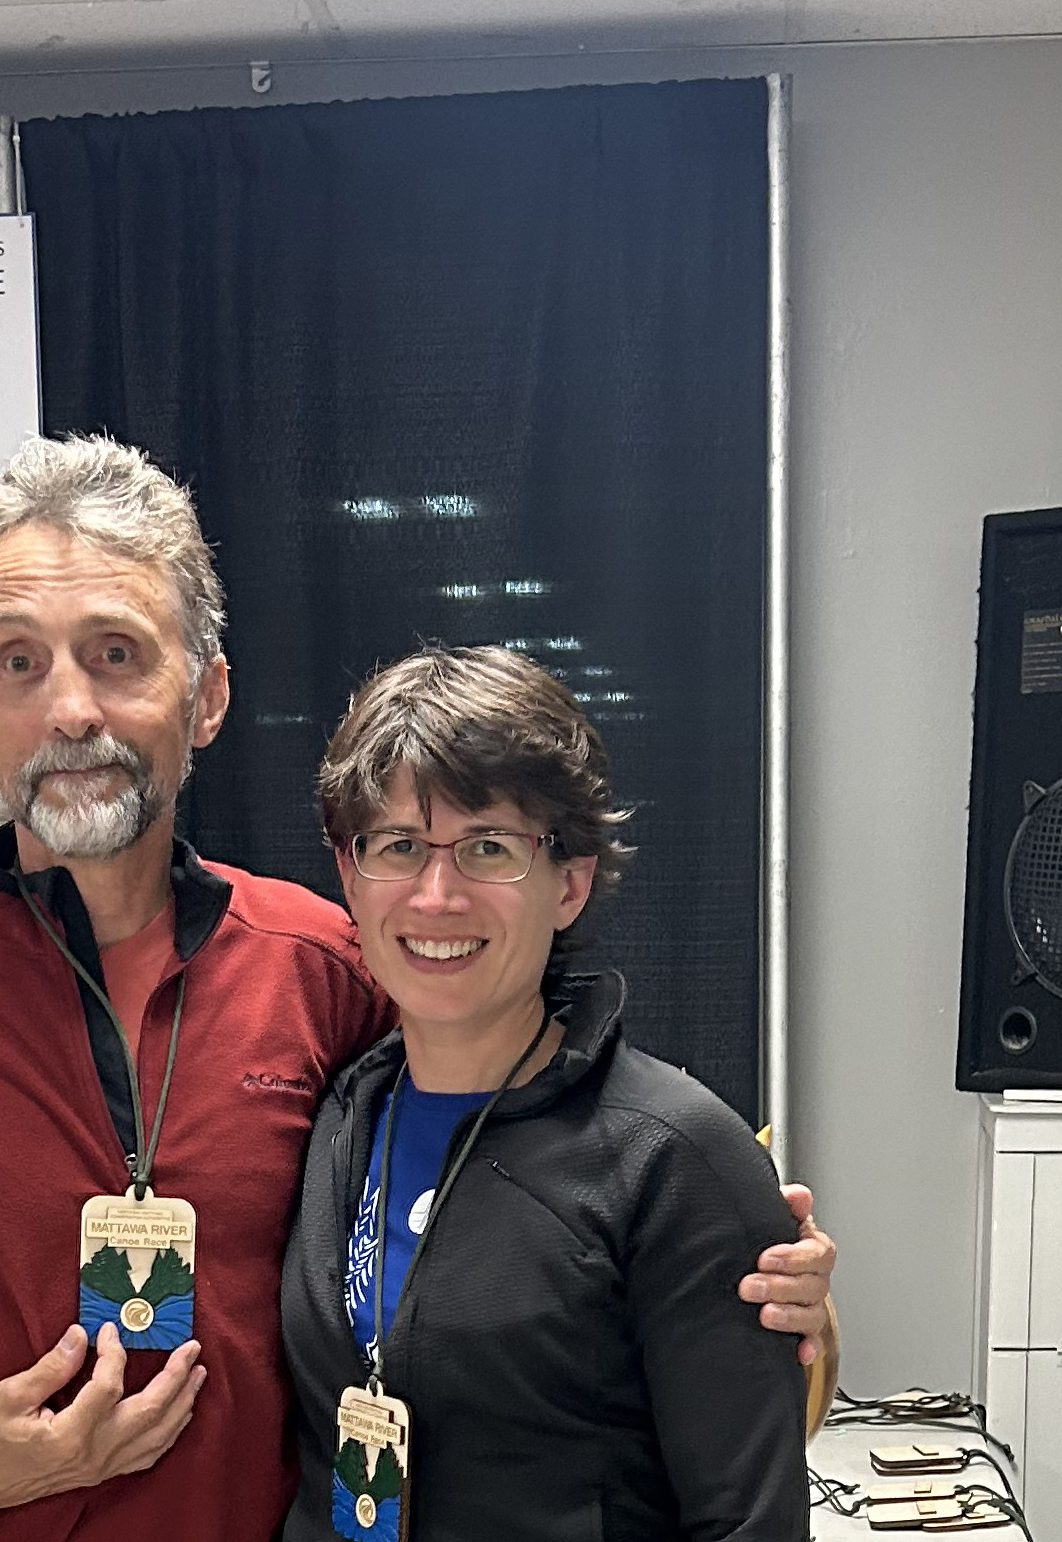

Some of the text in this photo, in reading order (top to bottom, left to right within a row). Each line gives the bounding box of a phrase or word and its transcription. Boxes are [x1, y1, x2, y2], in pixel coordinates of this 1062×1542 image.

[91, 1221, 188, 1236] MATTAWA RIVER
[109, 1236, 168, 1247] Canoe Race
